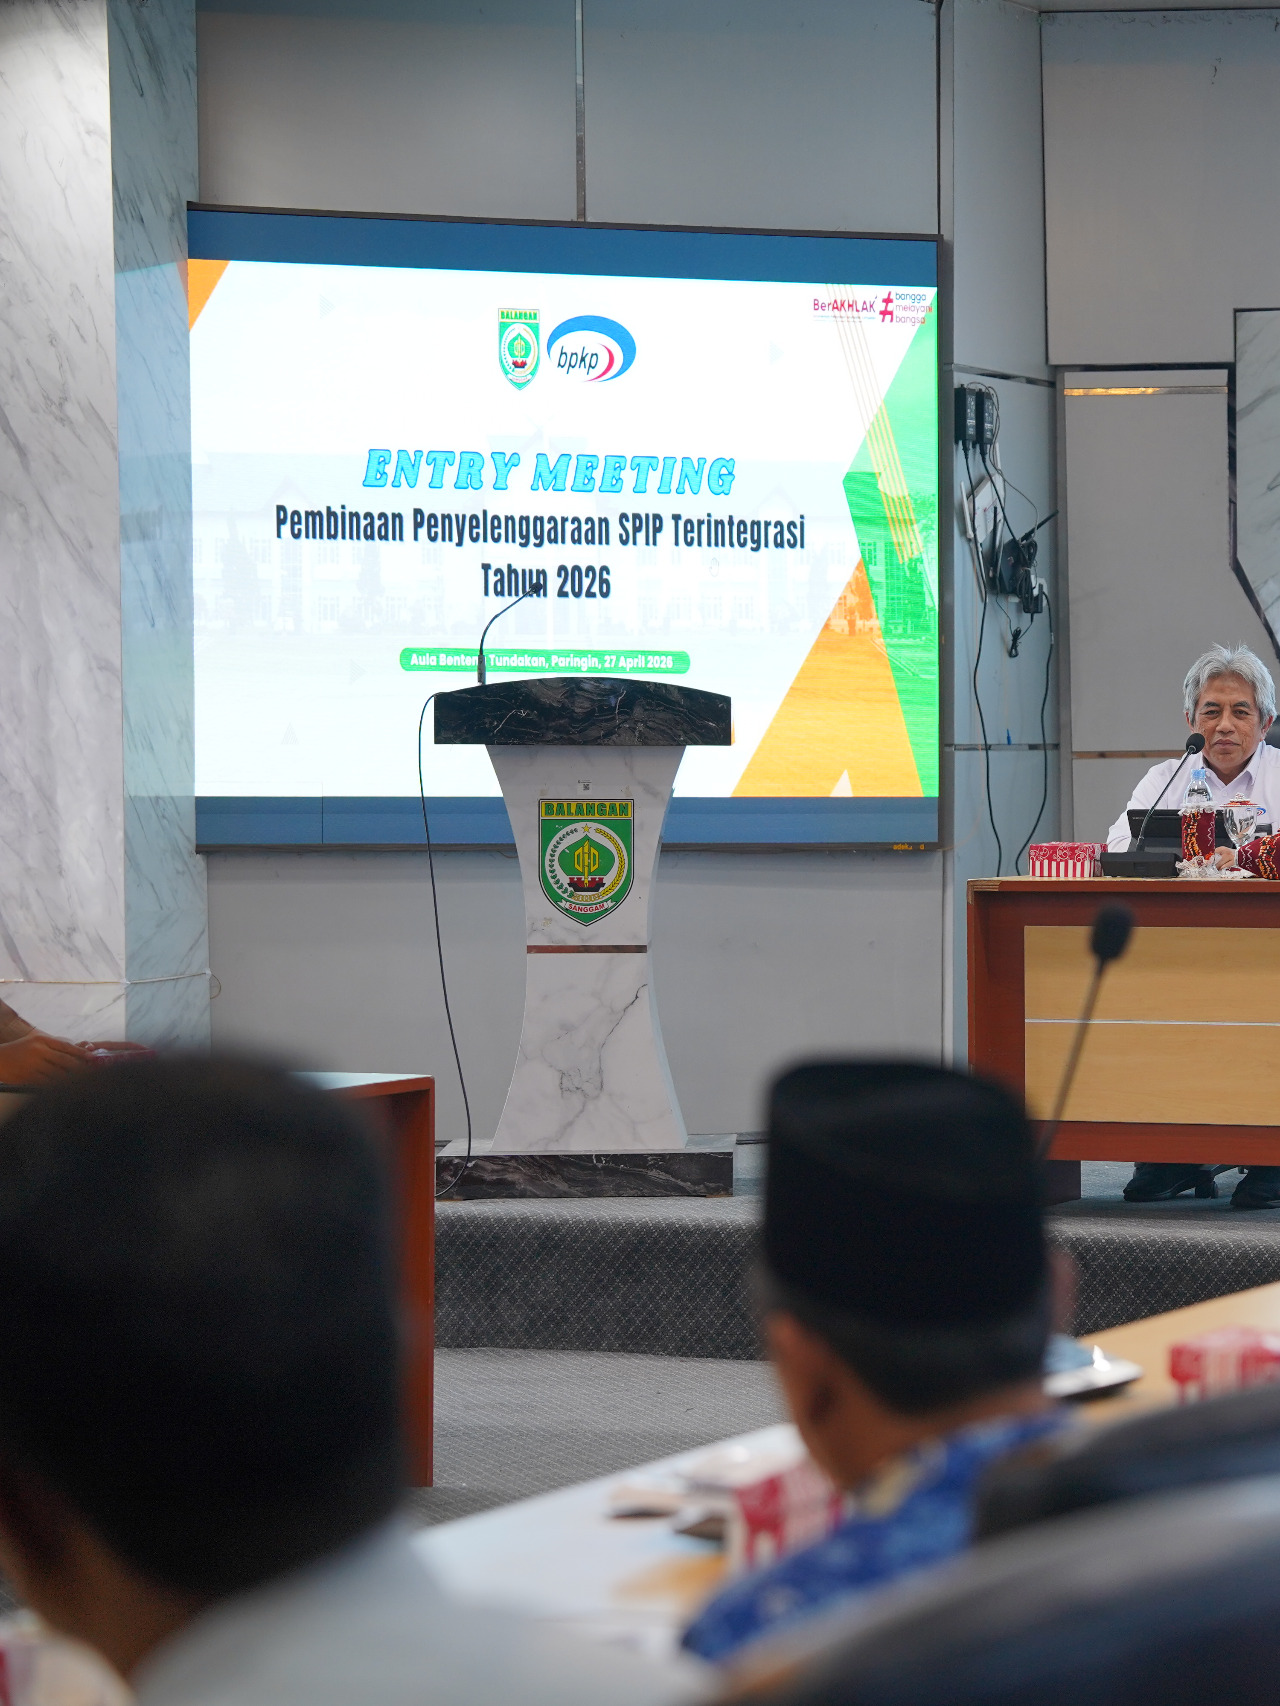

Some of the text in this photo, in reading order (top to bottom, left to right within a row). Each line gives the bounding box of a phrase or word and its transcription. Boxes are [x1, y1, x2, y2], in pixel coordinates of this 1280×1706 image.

[896, 292, 927, 304] bangga
[813, 298, 876, 313] BerAKHLAK
[896, 303, 933, 313] melayani
[500, 310, 538, 320] BALANGAN
[896, 315, 926, 326] bangsa
[557, 345, 599, 375] bpkp
[362, 448, 736, 496] ENTRY MEETING
[276, 504, 806, 552] Pembinaan Penyelenggaraan SPIP Terintegrasi
[482, 562, 611, 598] Tahun 2026
[411, 654, 673, 671] Aula Benten Tundakan, Paringin, 27 April 2026
[544, 803, 629, 816] BALANGAN
[568, 903, 605, 912] SANGGAM
